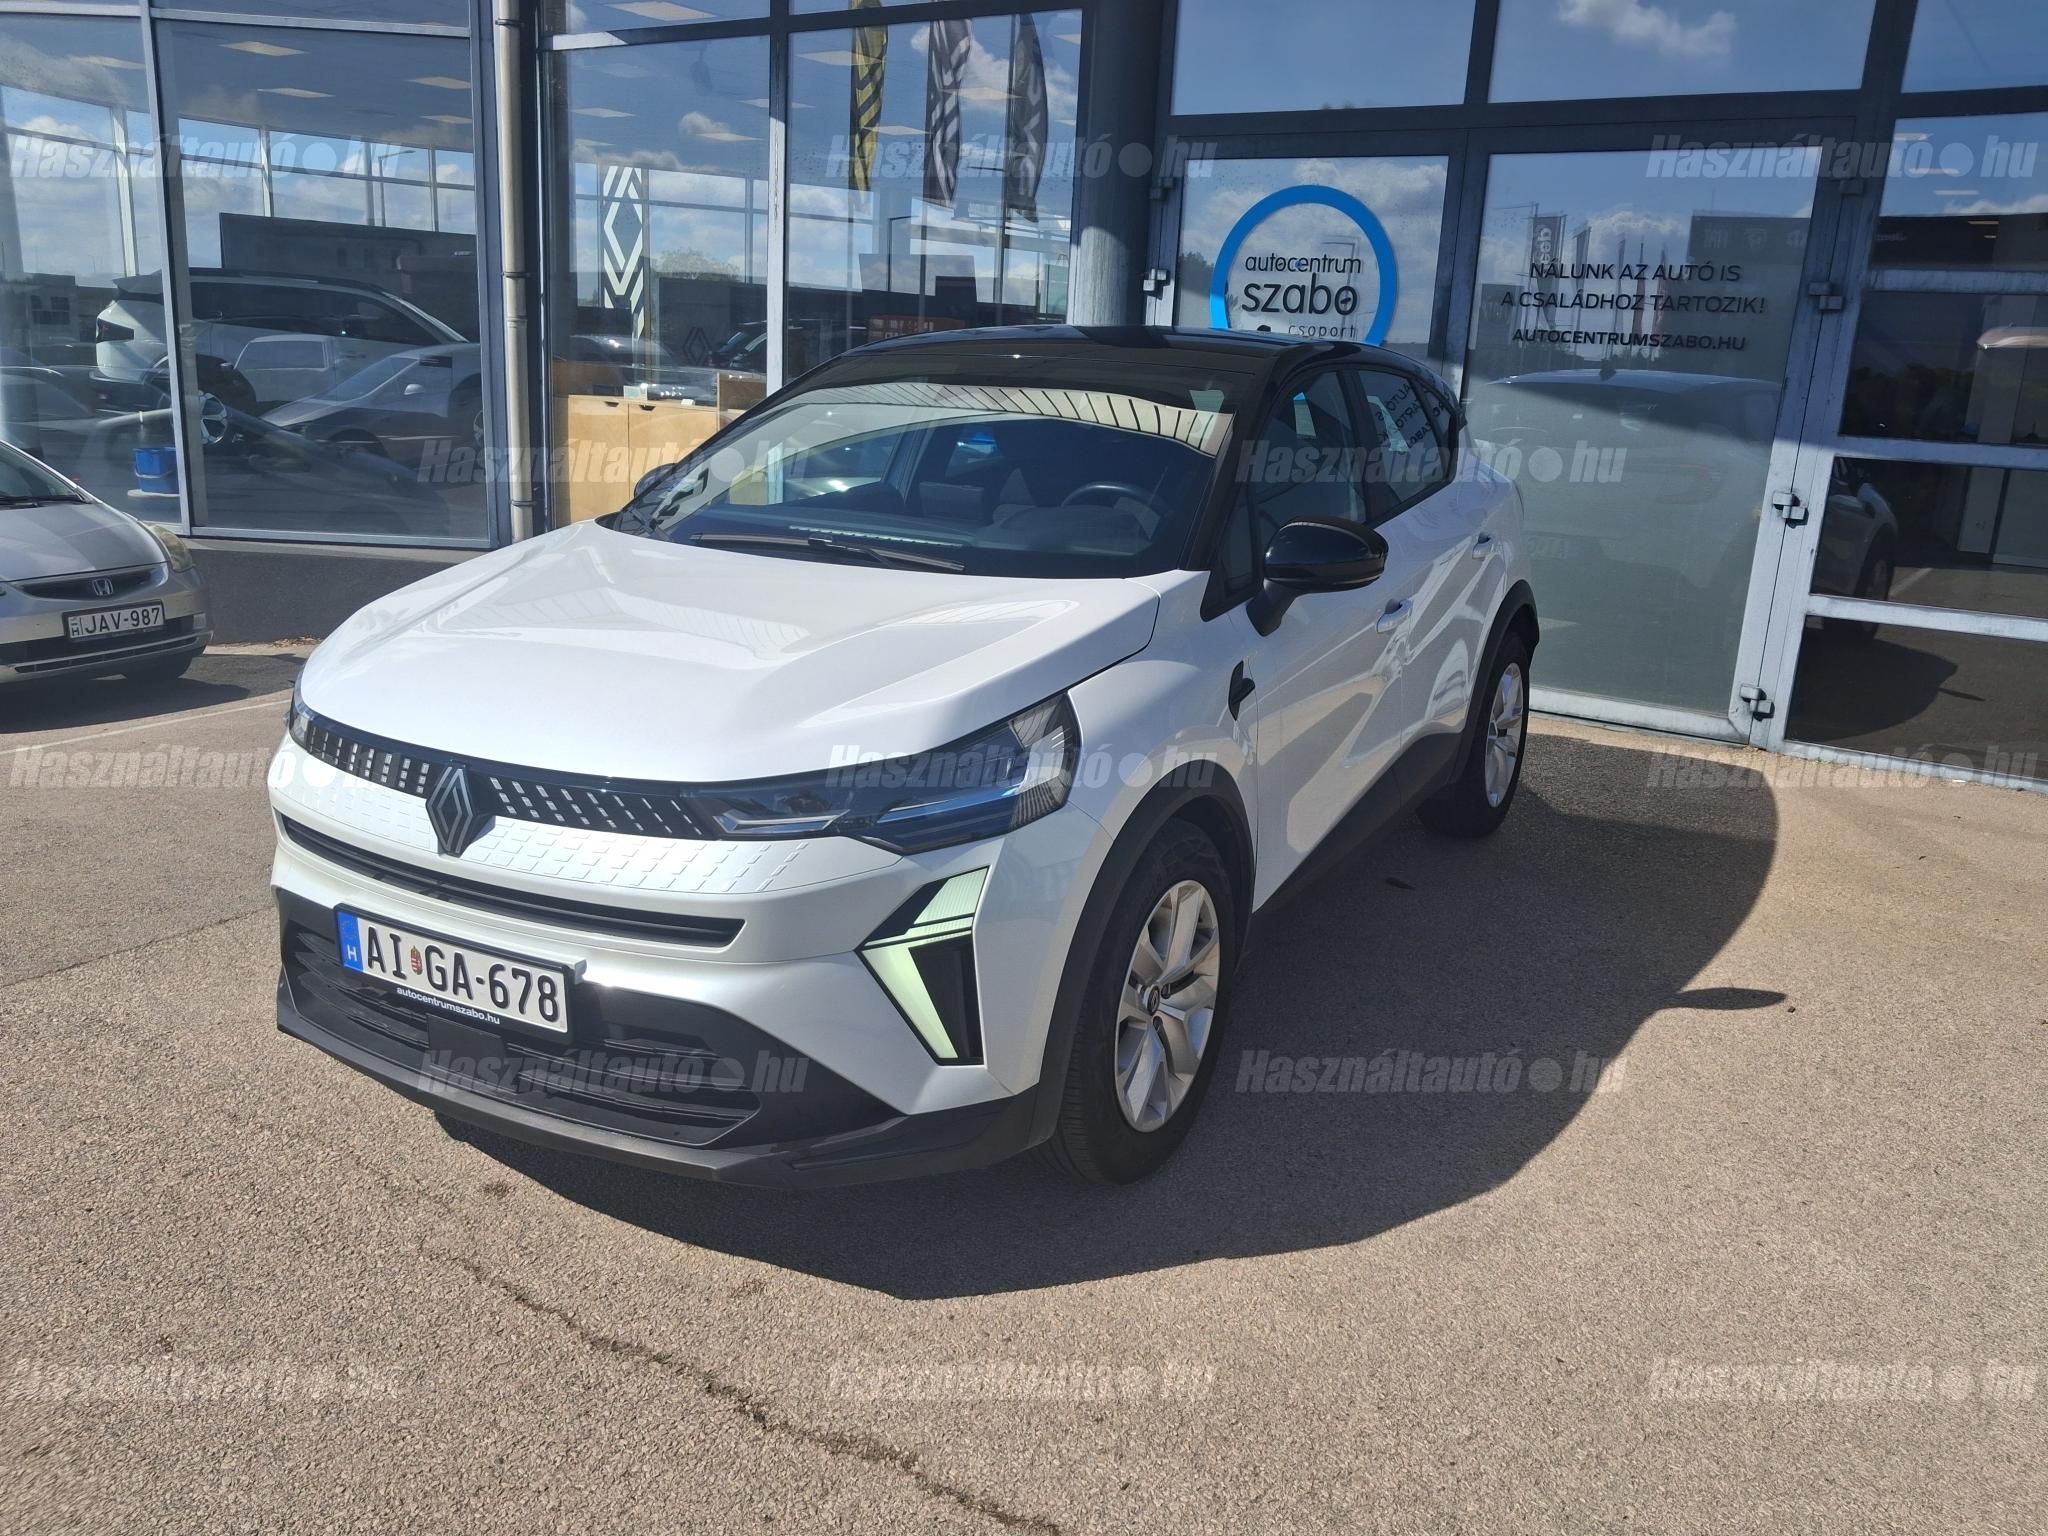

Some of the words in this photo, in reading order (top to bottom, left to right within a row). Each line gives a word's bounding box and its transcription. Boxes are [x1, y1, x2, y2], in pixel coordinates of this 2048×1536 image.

[1245, 252, 1362, 274] autocentrum
[1529, 257, 1615, 280] NÁLUNK
[1619, 263, 1649, 281] AZ
[1652, 260, 1715, 282] AUTÓ
[1719, 265, 1742, 282] IS
[1241, 272, 1358, 316] szabo
[1500, 291, 1514, 307] A
[1518, 288, 1645, 311] CSALÁDHOZ
[1649, 294, 1766, 314] TARTOZIK!
[1512, 328, 1747, 351] AUTOCENTRUMSZABO.HU
[85, 607, 160, 634] JAV-987
[346, 945, 357, 962] H
[367, 926, 407, 980] AI
[424, 944, 559, 1023] GA-678
[396, 986, 501, 1025] autocentrumszabo.hu
